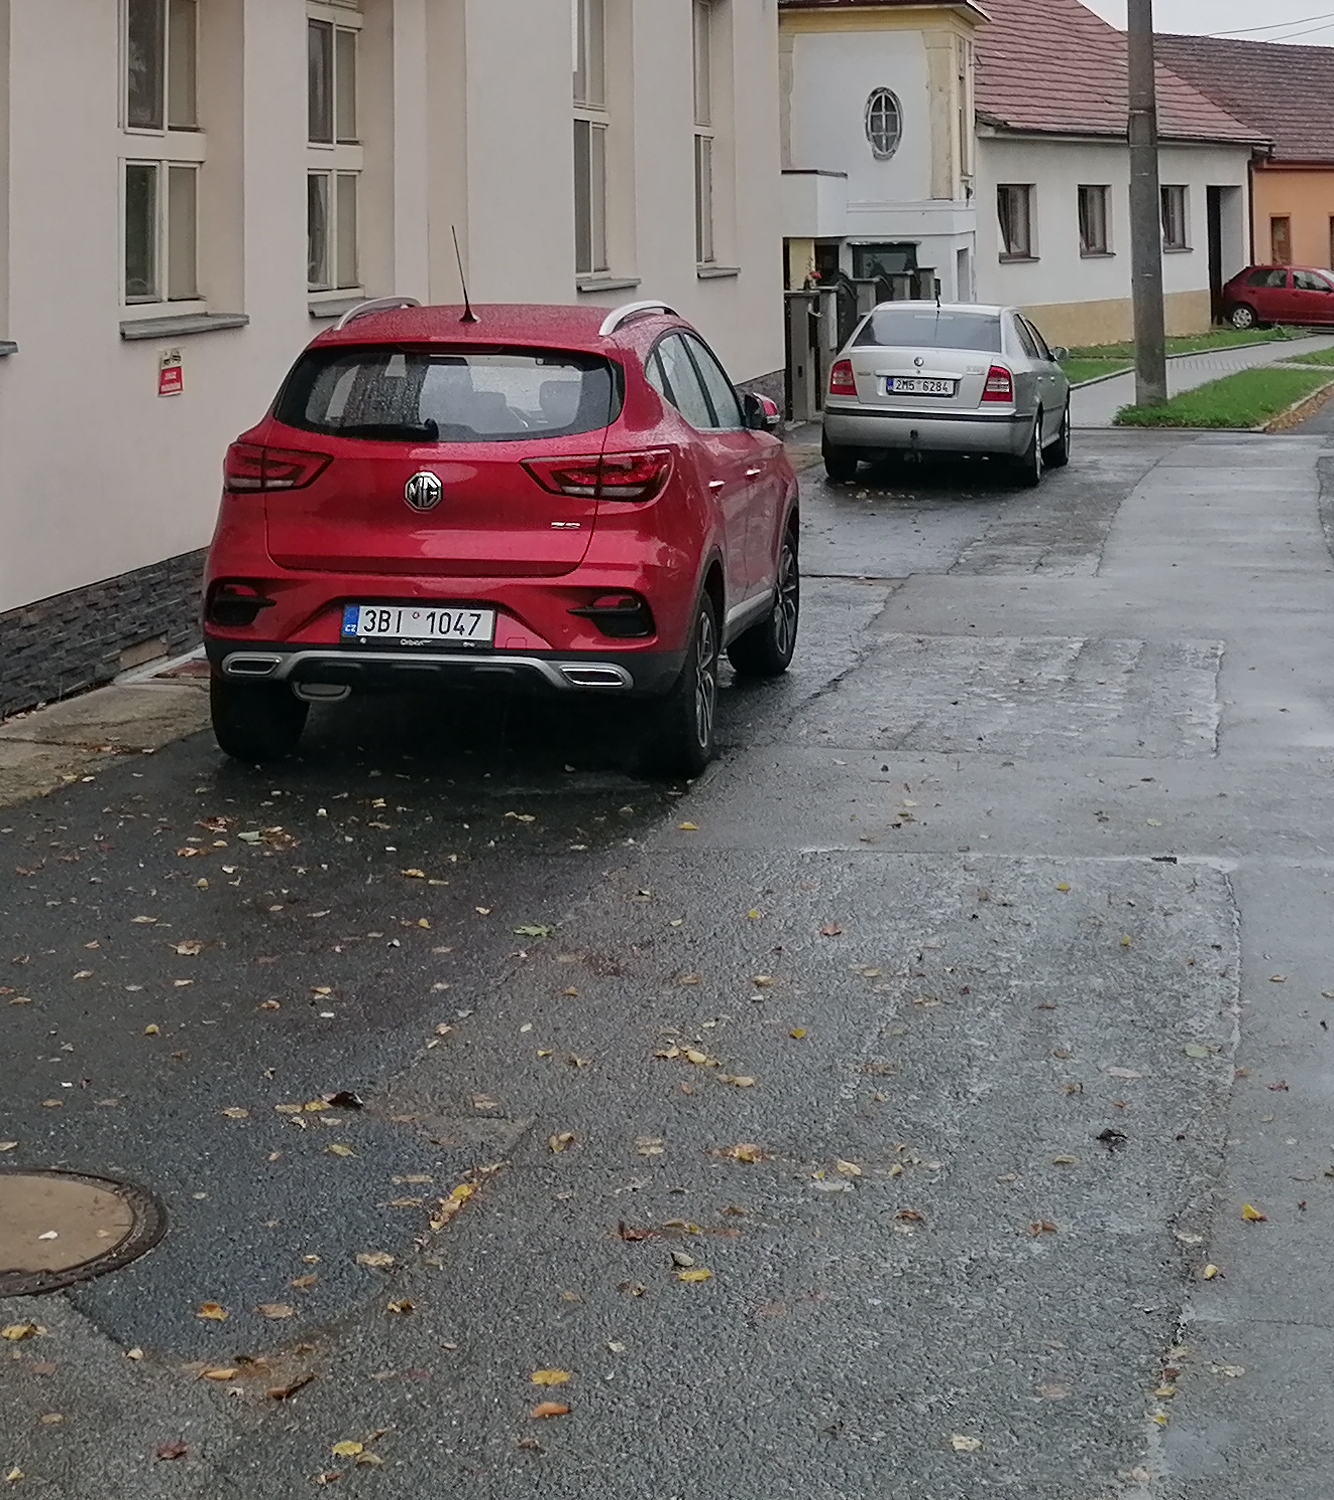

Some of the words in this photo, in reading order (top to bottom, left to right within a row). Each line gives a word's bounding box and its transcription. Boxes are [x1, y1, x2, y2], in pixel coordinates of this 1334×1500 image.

[895, 379, 915, 391] 2M5
[922, 381, 950, 392] 6284
[408, 476, 439, 508] MG
[363, 609, 402, 633] 3BI
[425, 611, 482, 636] 1047
